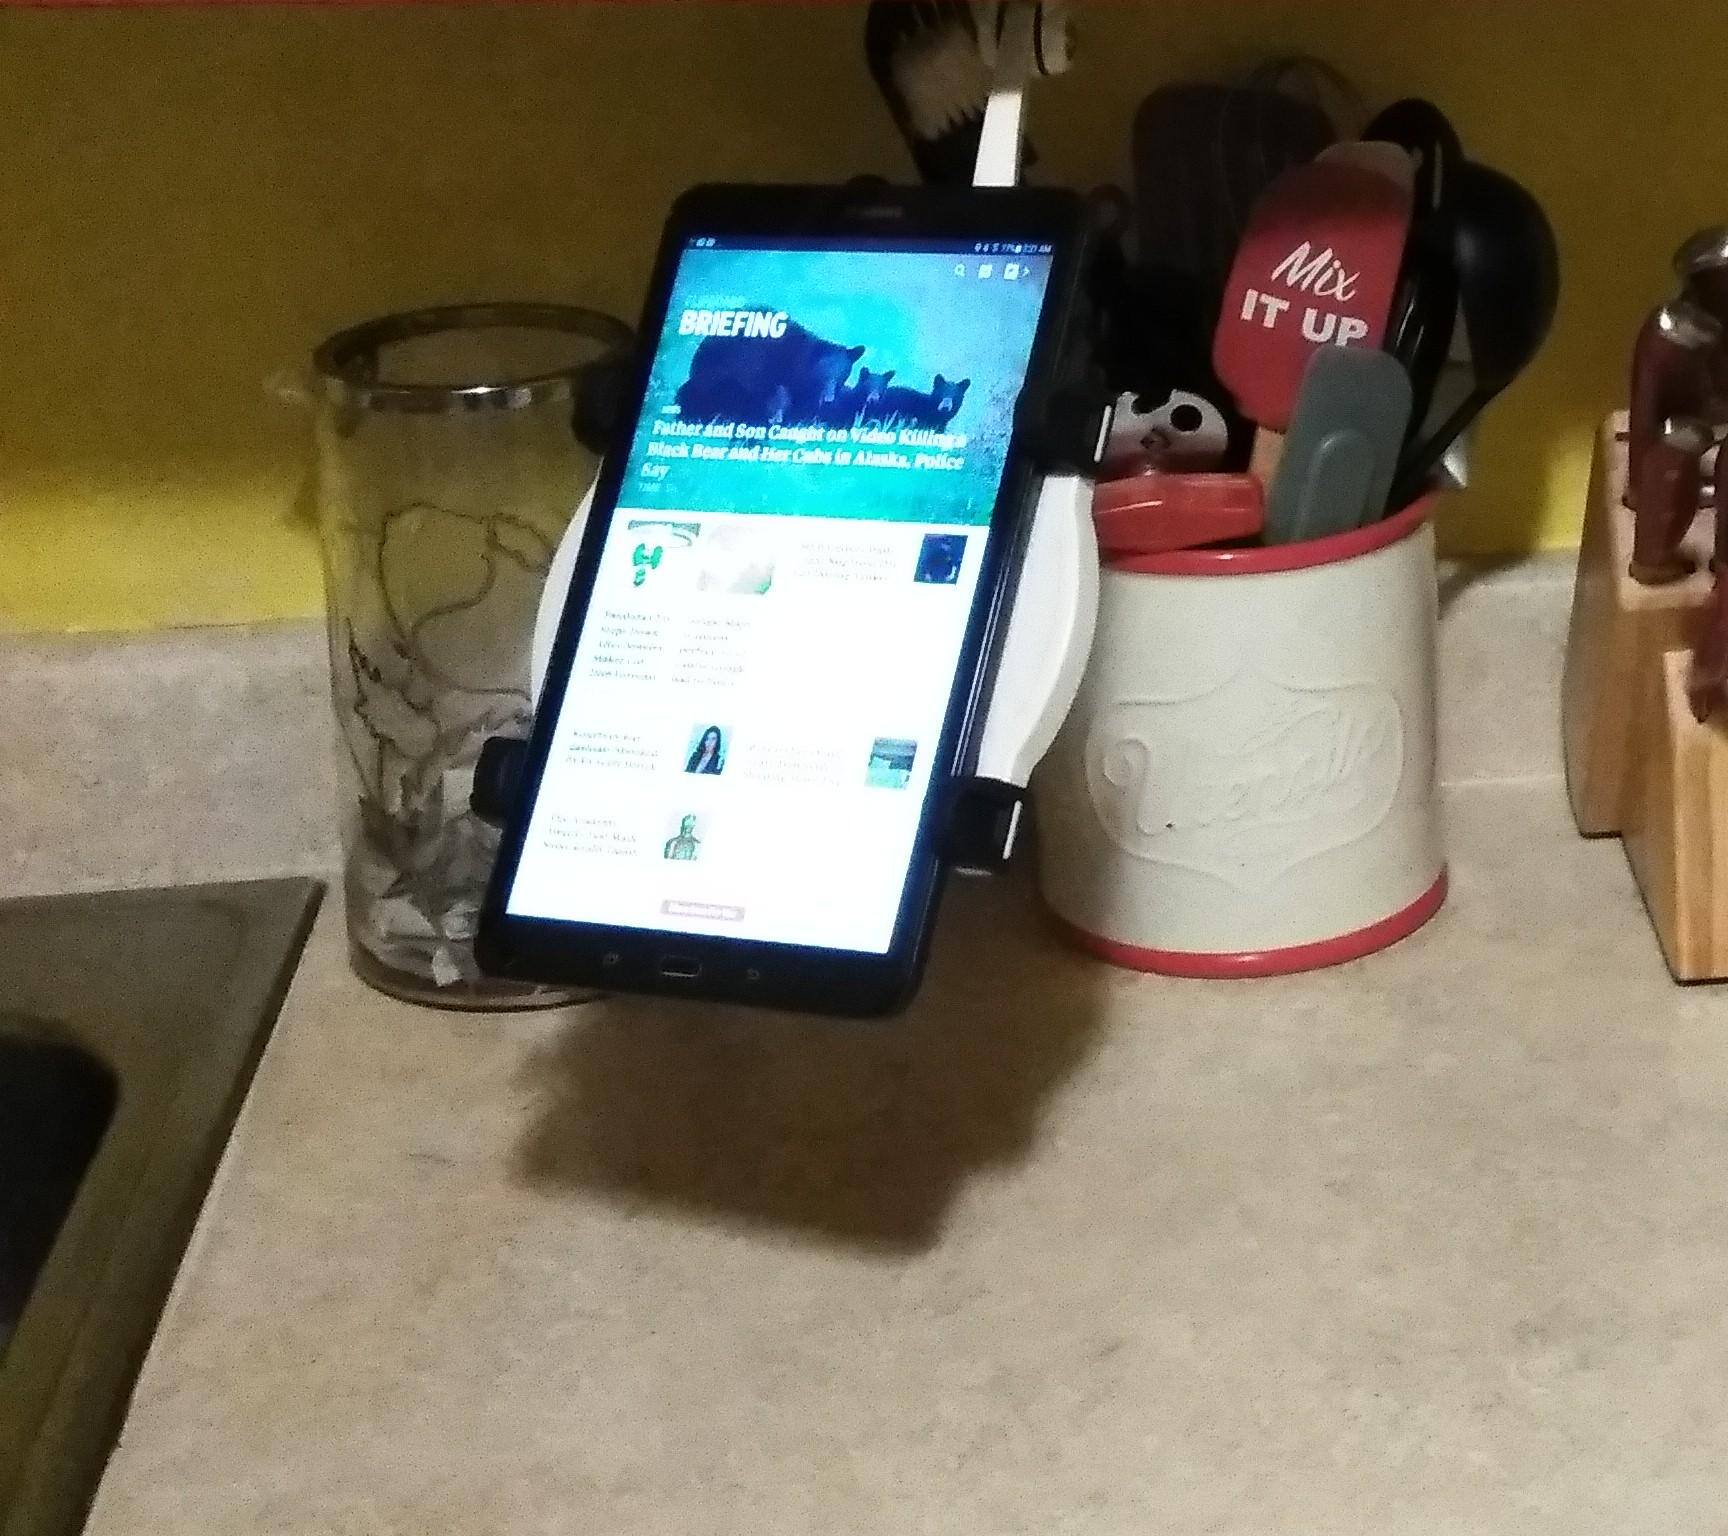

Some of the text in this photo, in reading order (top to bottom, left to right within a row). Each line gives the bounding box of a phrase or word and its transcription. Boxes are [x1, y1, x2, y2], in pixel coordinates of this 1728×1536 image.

[1270, 240, 1361, 302] Mix
[678, 308, 789, 339] BRIEFING
[1240, 288, 1369, 347] IT UP
[735, 424, 766, 441] Son
